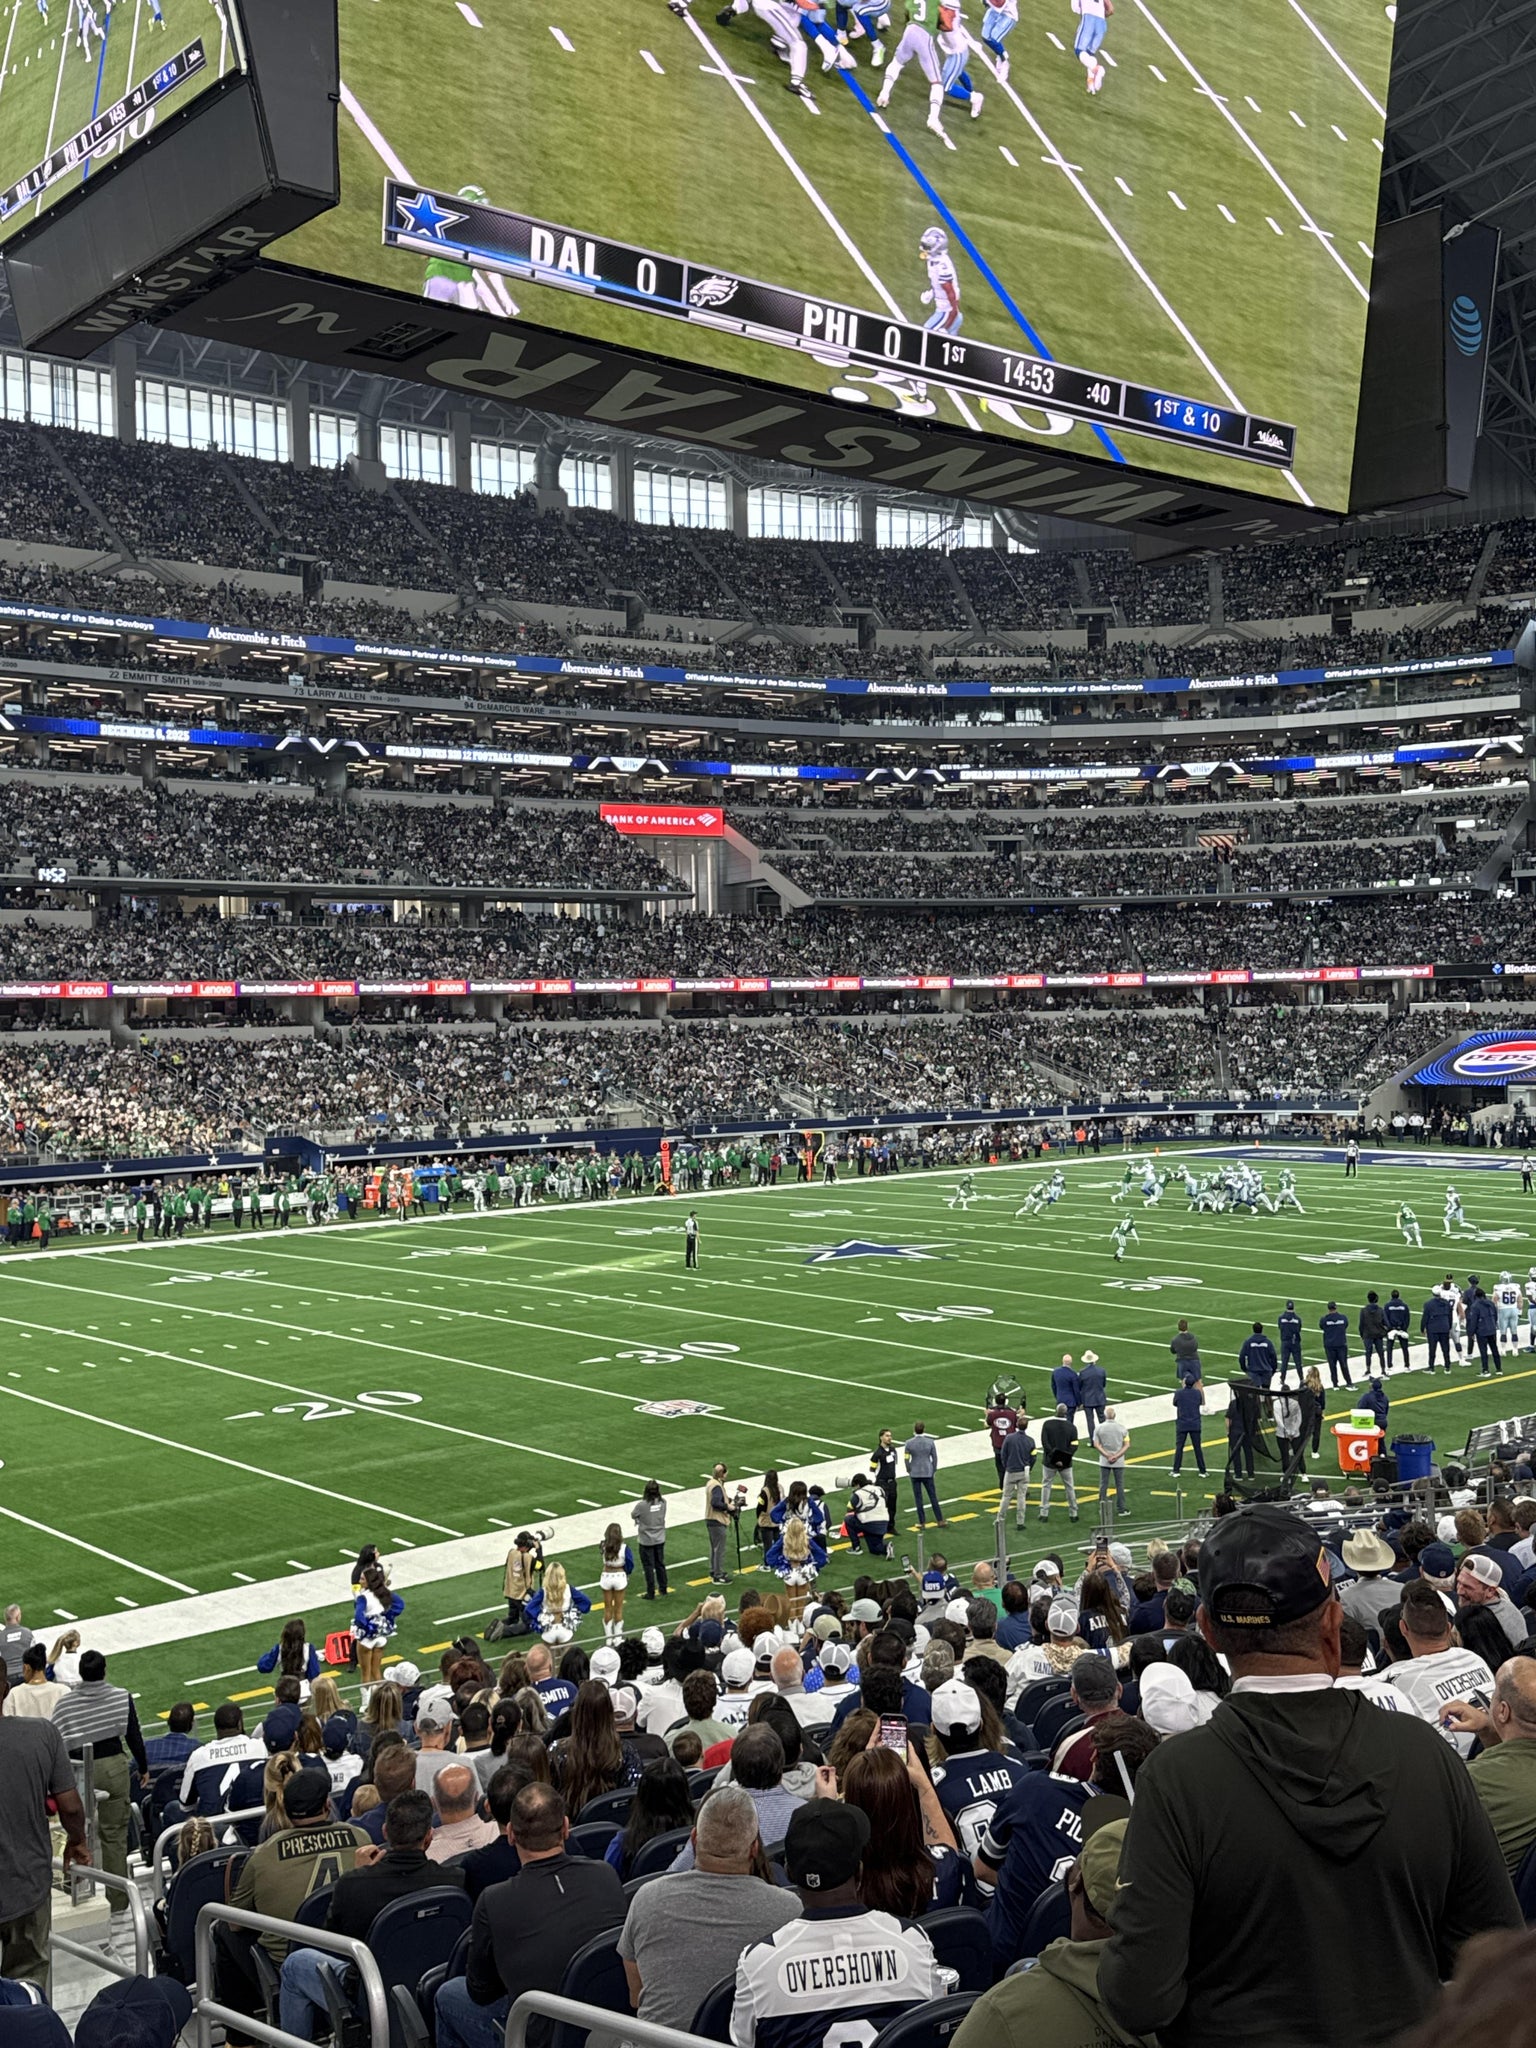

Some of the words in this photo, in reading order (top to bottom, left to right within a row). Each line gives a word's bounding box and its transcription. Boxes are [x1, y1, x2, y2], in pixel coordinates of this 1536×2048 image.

[64, 142, 78, 163] PHI
[81, 134, 88, 151] 0
[169, 63, 178, 77] 10
[73, 225, 276, 334] WINSTAR
[531, 227, 601, 281] DAL
[636, 258, 657, 295] 0
[803, 301, 858, 349] PHI
[884, 325, 901, 360] 0
[942, 341, 966, 366] 1ST
[1002, 357, 1055, 394] 14:53
[1086, 383, 1111, 406] :40
[1154, 398, 1180, 418] 1ST
[1183, 406, 1195, 426] &
[1201, 411, 1221, 433] 10
[426, 332, 1185, 528] WINSTAR
[27, 609, 58, 619] Partner
[61, 612, 71, 620] of
[72, 614, 86, 623] the
[88, 616, 114, 626] Dallas
[116, 619, 154, 630] Cowboys
[207, 627, 269, 644] Abercrombie
[270, 636, 278, 645] &
[280, 635, 306, 648] Fitch
[355, 645, 381, 654] Official
[384, 647, 411, 656] Fashion
[412, 650, 438, 659] Partner
[439, 652, 447, 660] of
[449, 653, 461, 661] the
[462, 654, 484, 663] Dallas
[484, 657, 516, 667] Cowboys
[560, 662, 612, 676] Abercrombie
[614, 667, 621, 676] &
[622, 667, 644, 678] Fitch
[1324, 669, 1352, 678] Official
[1353, 667, 1382, 676] Fashion
[1382, 665, 1410, 673] Partner
[1411, 663, 1420, 671] of
[1420, 662, 1432, 670] the
[1434, 660, 1456, 668] Dallas
[1458, 656, 1492, 665] Cowboys
[109, 671, 119, 679] 22
[122, 672, 159, 683] EMMITT
[162, 676, 190, 686] SMITH
[685, 672, 708, 681] Official
[710, 674, 733, 683] Fashion
[734, 676, 758, 685] Partner
[759, 678, 766, 686] of
[767, 679, 777, 687] the
[778, 679, 798, 687] Dallas
[798, 680, 826, 689] Cowboys
[1188, 677, 1244, 689] Abercrombie
[1246, 677, 1253, 685] &
[1254, 674, 1278, 685] Fitch
[293, 688, 304, 696] 73
[308, 689, 336, 698] LARRY
[338, 692, 366, 701] ALLEN
[866, 682, 917, 693] Abercrombie
[918, 685, 925, 694] &
[926, 684, 947, 694] Fitch
[990, 686, 1014, 694] Official
[1016, 686, 1041, 694] Fashion
[1042, 685, 1067, 693] Partner
[1068, 685, 1076, 693] of
[1078, 685, 1088, 693] the
[1089, 684, 1110, 692] Dallas
[1112, 683, 1144, 691] Cowboys
[464, 701, 474, 709] 94
[522, 706, 545, 715] WARE
[605, 814, 634, 825] BANK
[636, 815, 649, 824] OF
[651, 816, 695, 826] AMERICA
[1217, 972, 1245, 982] Lenovo
[1326, 969, 1354, 979] Lenovo
[69, 985, 104, 994] Lenovo
[200, 984, 232, 993] Lenovo
[322, 983, 352, 992] Lenovo
[434, 982, 463, 992] Lenovo
[542, 981, 568, 991] Lenovo
[643, 980, 669, 990] Lenovo
[740, 979, 765, 989] Lenovo
[1100, 1275, 1203, 1291] 50
[1502, 1291, 1517, 1305] 66
[896, 1305, 994, 1322] 40
[615, 1341, 741, 1364] 30
[271, 1390, 424, 1421] 20
[1348, 1440, 1369, 1462] G
[1220, 1614, 1236, 1623] U.S.
[1236, 1614, 1271, 1625] MARINES
[1435, 1666, 1490, 1701] OVERSHOWN
[539, 1687, 570, 1705] SMITH
[209, 1743, 248, 1760] PRESCOTT
[965, 1768, 1013, 1798] LAMB
[281, 1829, 351, 1858] PRESCOTT
[785, 1949, 898, 1993] OVERSHOWN
